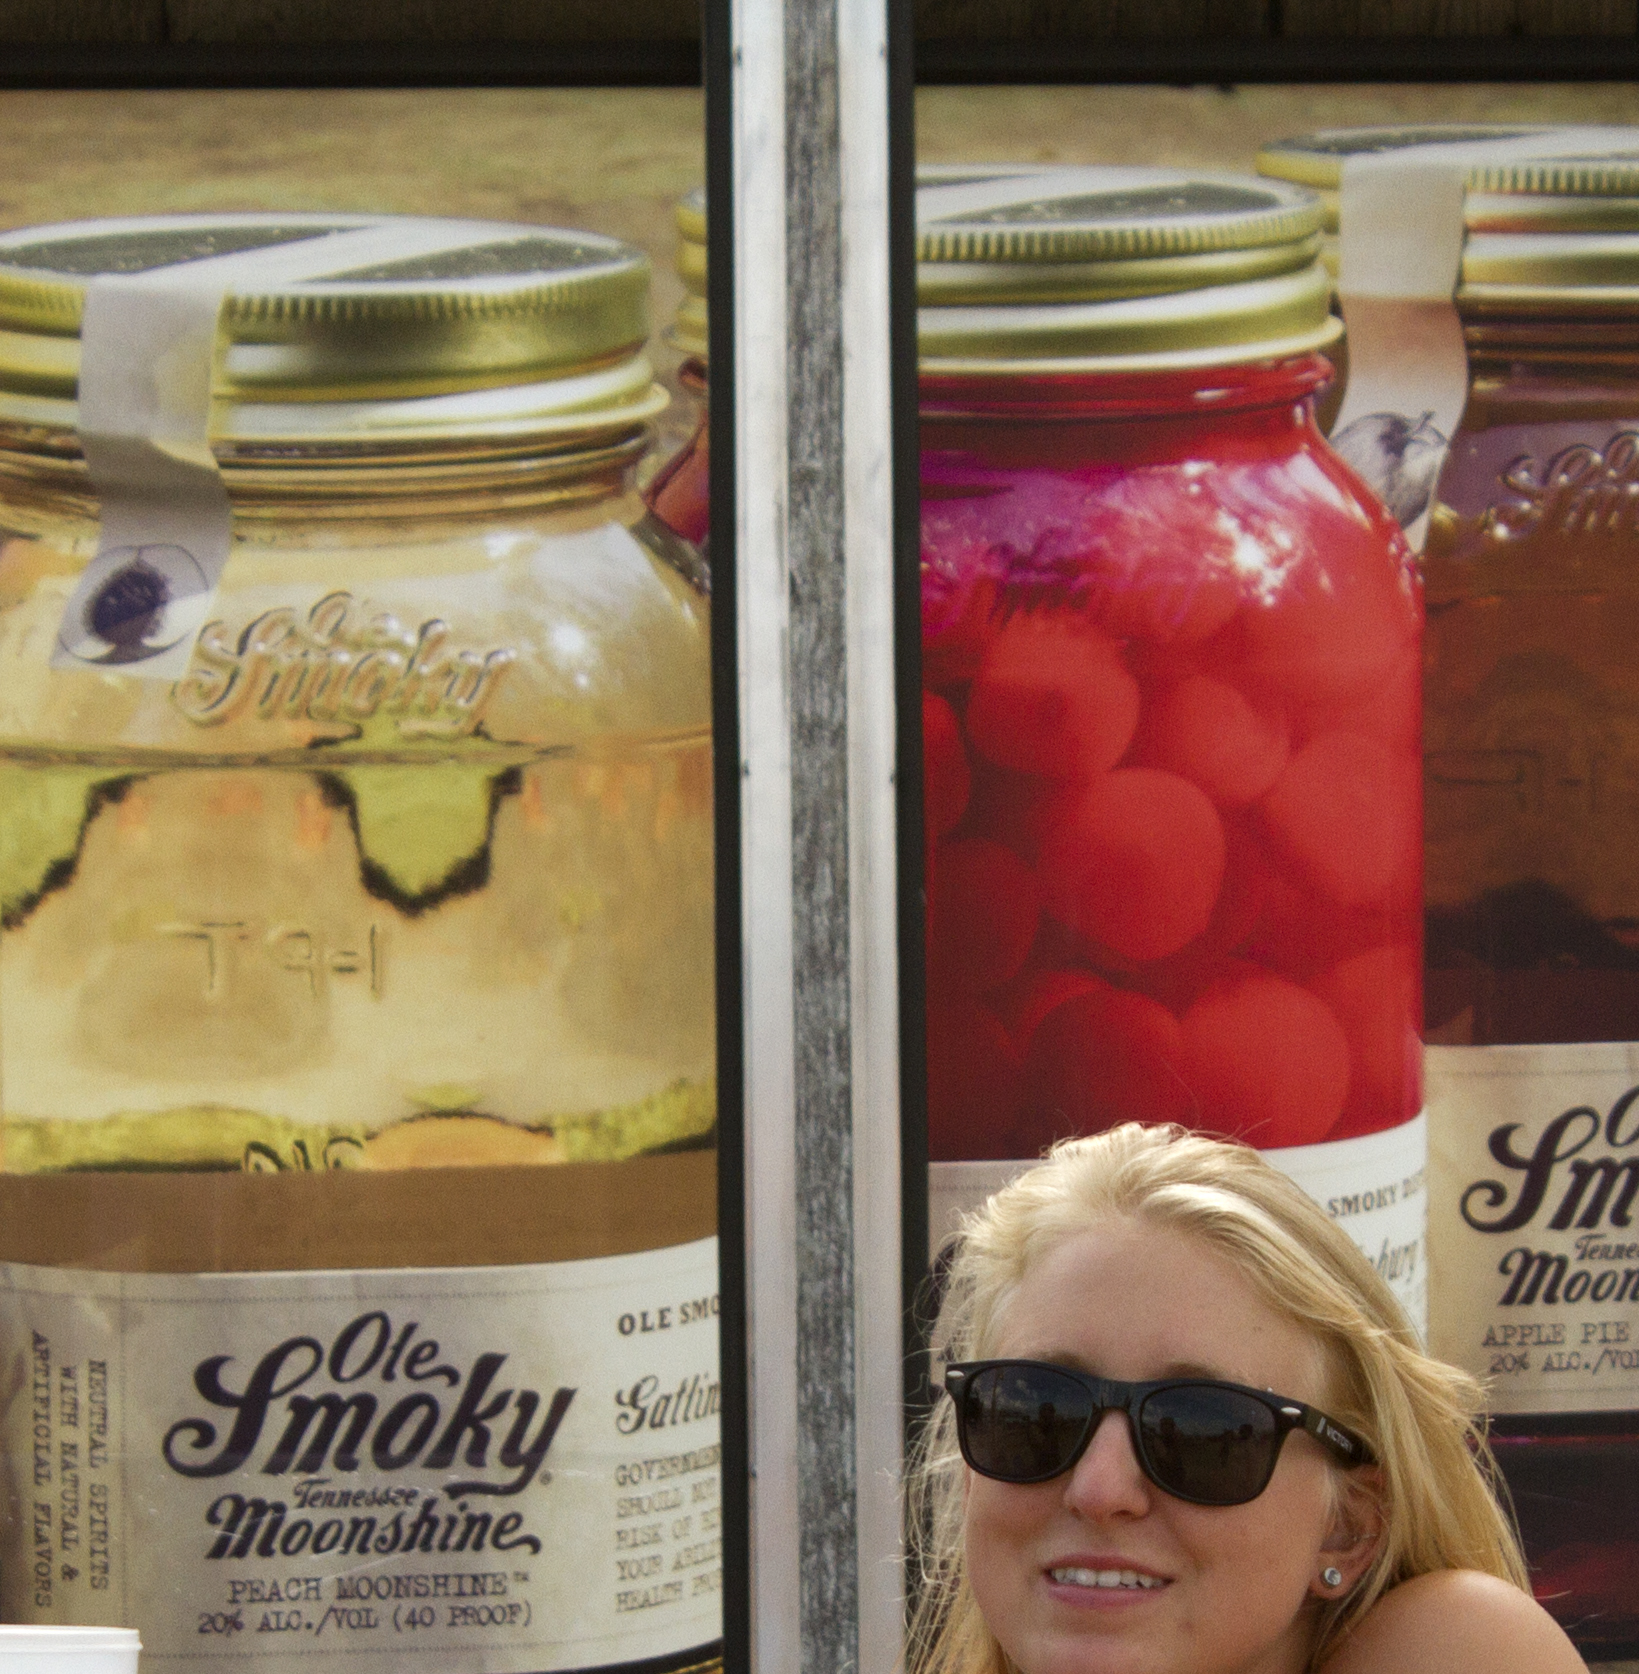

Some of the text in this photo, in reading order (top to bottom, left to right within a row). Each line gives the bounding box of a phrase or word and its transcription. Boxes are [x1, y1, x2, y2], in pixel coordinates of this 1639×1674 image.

[1327, 1184, 1398, 1219] SMOKY
[617, 1306, 673, 1337] OLE
[1481, 1322, 1566, 1348] APPLE
[1580, 1319, 1630, 1345] PIE
[327, 1310, 461, 1387] Ole
[1489, 1350, 1530, 1375] 20%
[160, 1336, 580, 1498] Smoky
[61, 1440, 81, 1551] NATURAL
[292, 1477, 420, 1510] Tennessee
[89, 1482, 111, 1591] SPIRITS
[205, 1492, 542, 1560] Moonshine
[33, 1501, 54, 1610] FLAVORS
[227, 1577, 324, 1604] PEACH
[197, 1600, 534, 1638] 20% ALC./VOL (40 PROOF)
